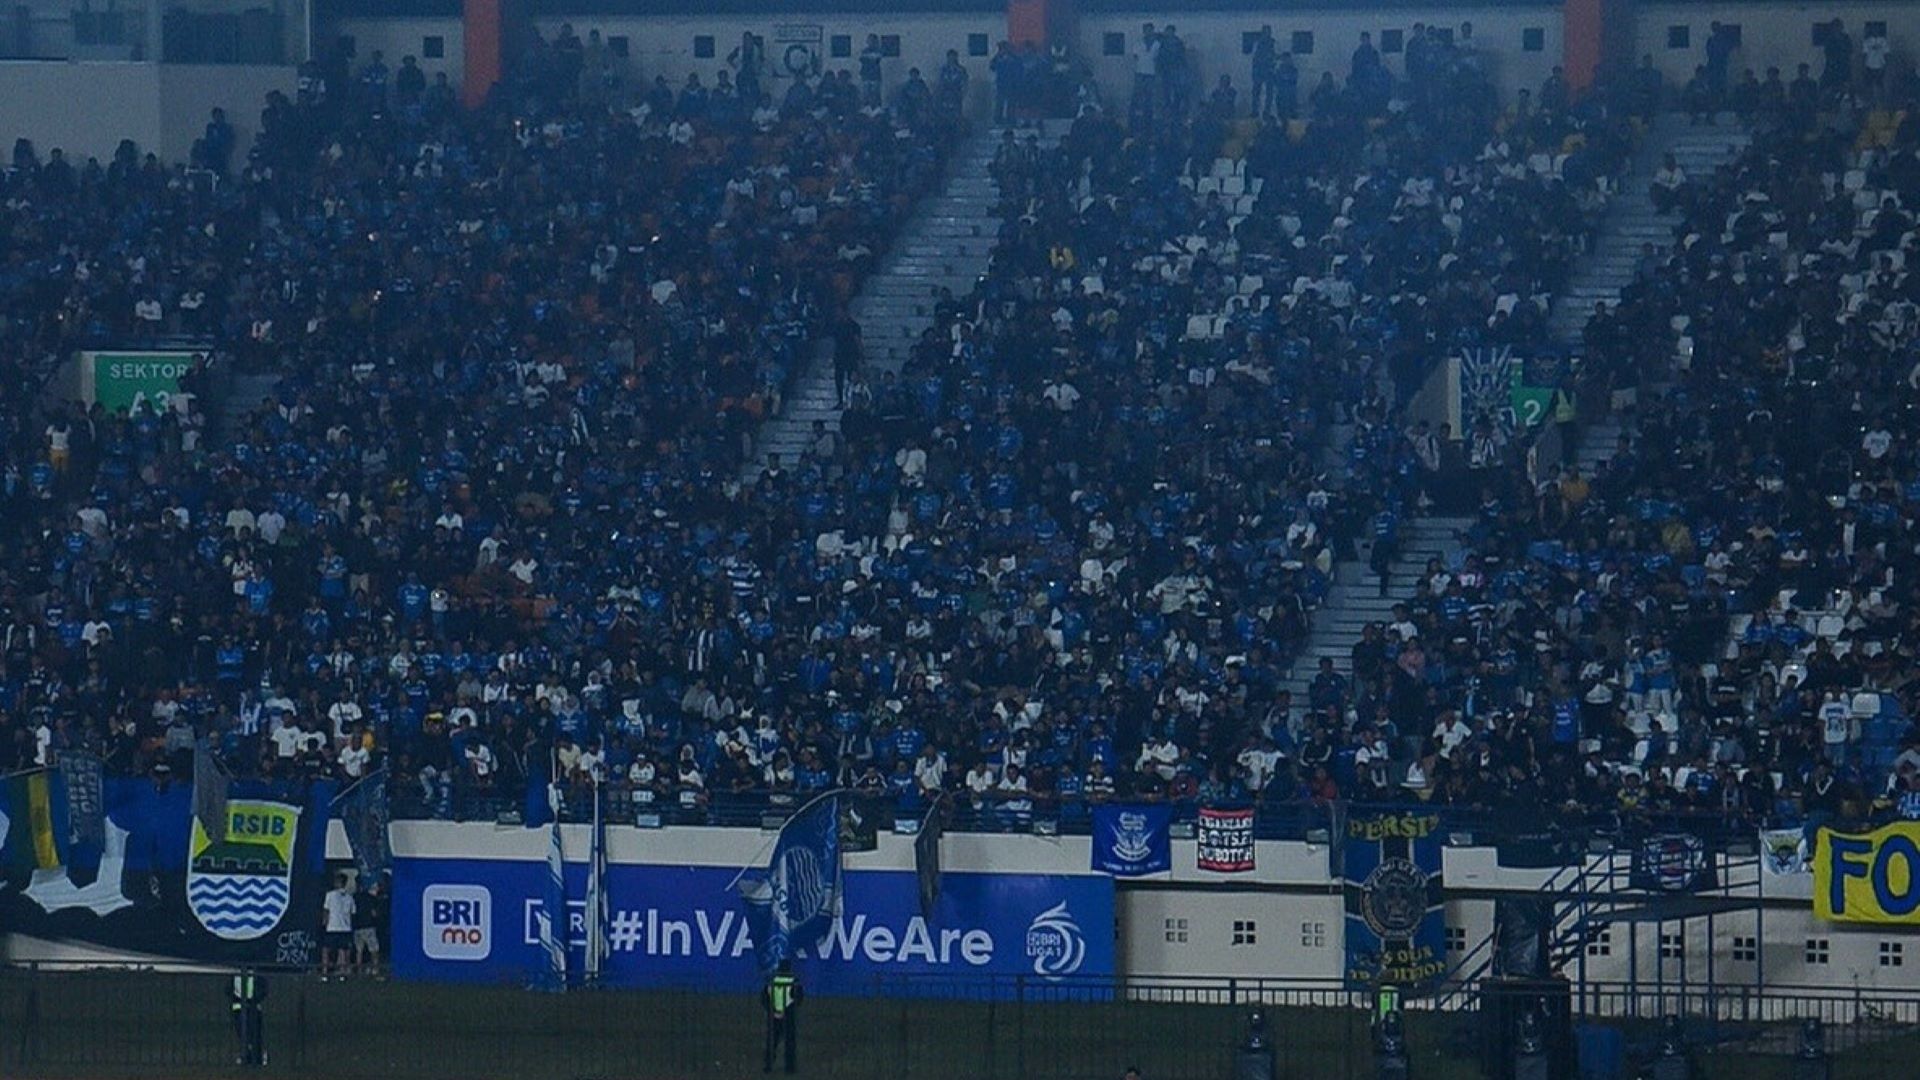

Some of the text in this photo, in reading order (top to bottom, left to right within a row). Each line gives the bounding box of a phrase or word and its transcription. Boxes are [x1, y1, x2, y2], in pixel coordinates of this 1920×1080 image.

[110, 363, 188, 379] SEKTOR
[228, 812, 286, 836] RSIB
[433, 900, 480, 926] BRI
[442, 928, 482, 944] mo
